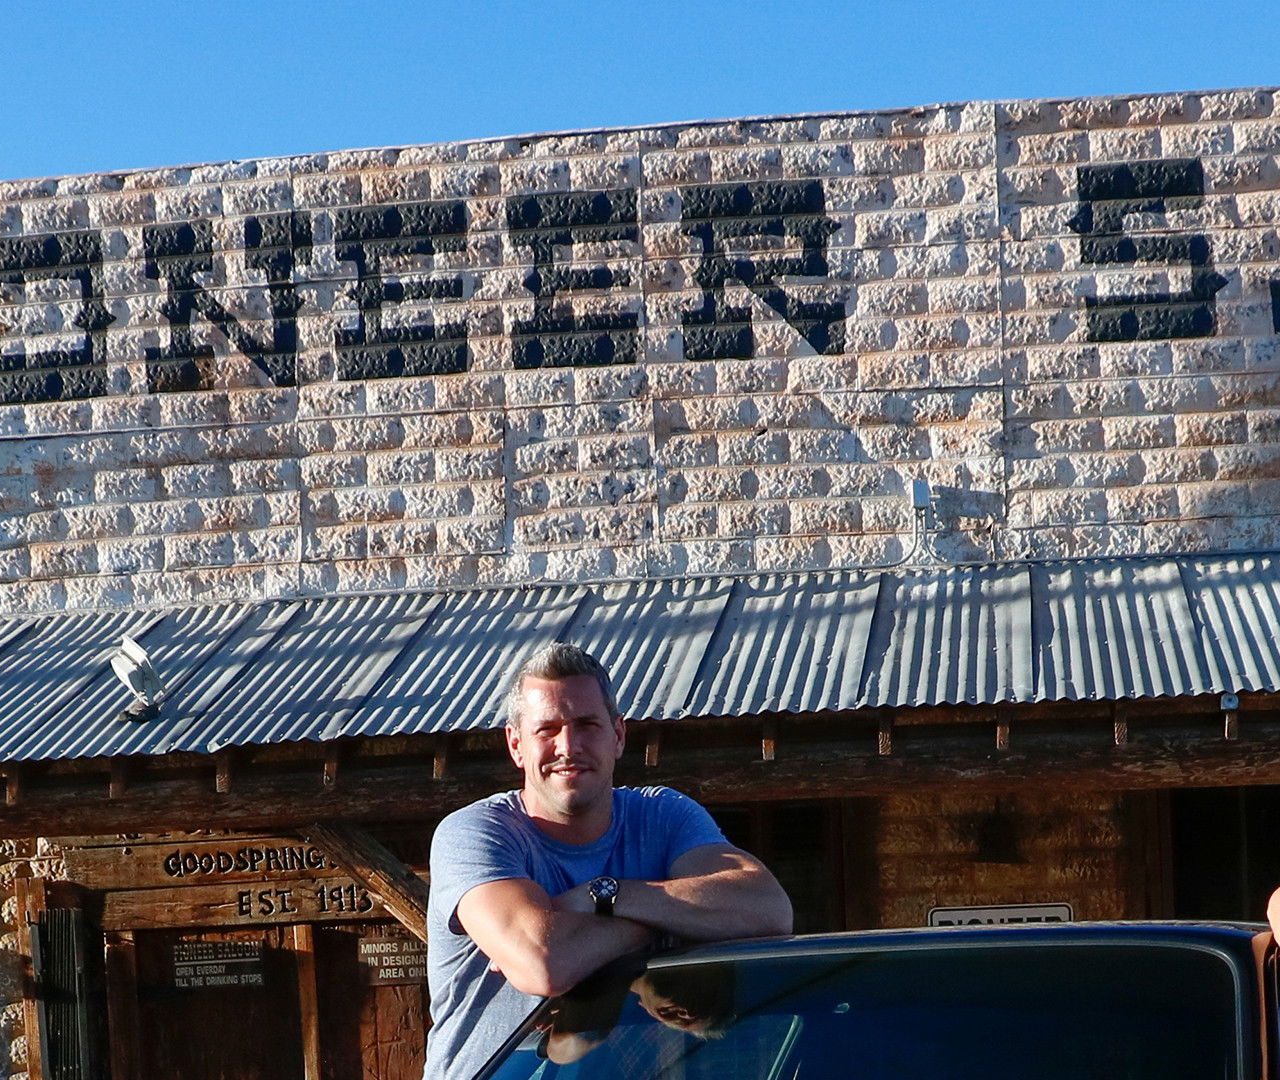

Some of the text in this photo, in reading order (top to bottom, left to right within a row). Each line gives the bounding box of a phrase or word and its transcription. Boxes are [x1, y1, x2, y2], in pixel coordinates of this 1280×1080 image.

[174, 941, 259, 961] PIONEER SALOON
[361, 942, 426, 954] MINORS ALLO
[368, 957, 378, 967] IN
[176, 967, 194, 976] OPEN
[379, 968, 427, 979] AREA ONL
[175, 974, 262, 987] TILL THE DRINKING STOPS
